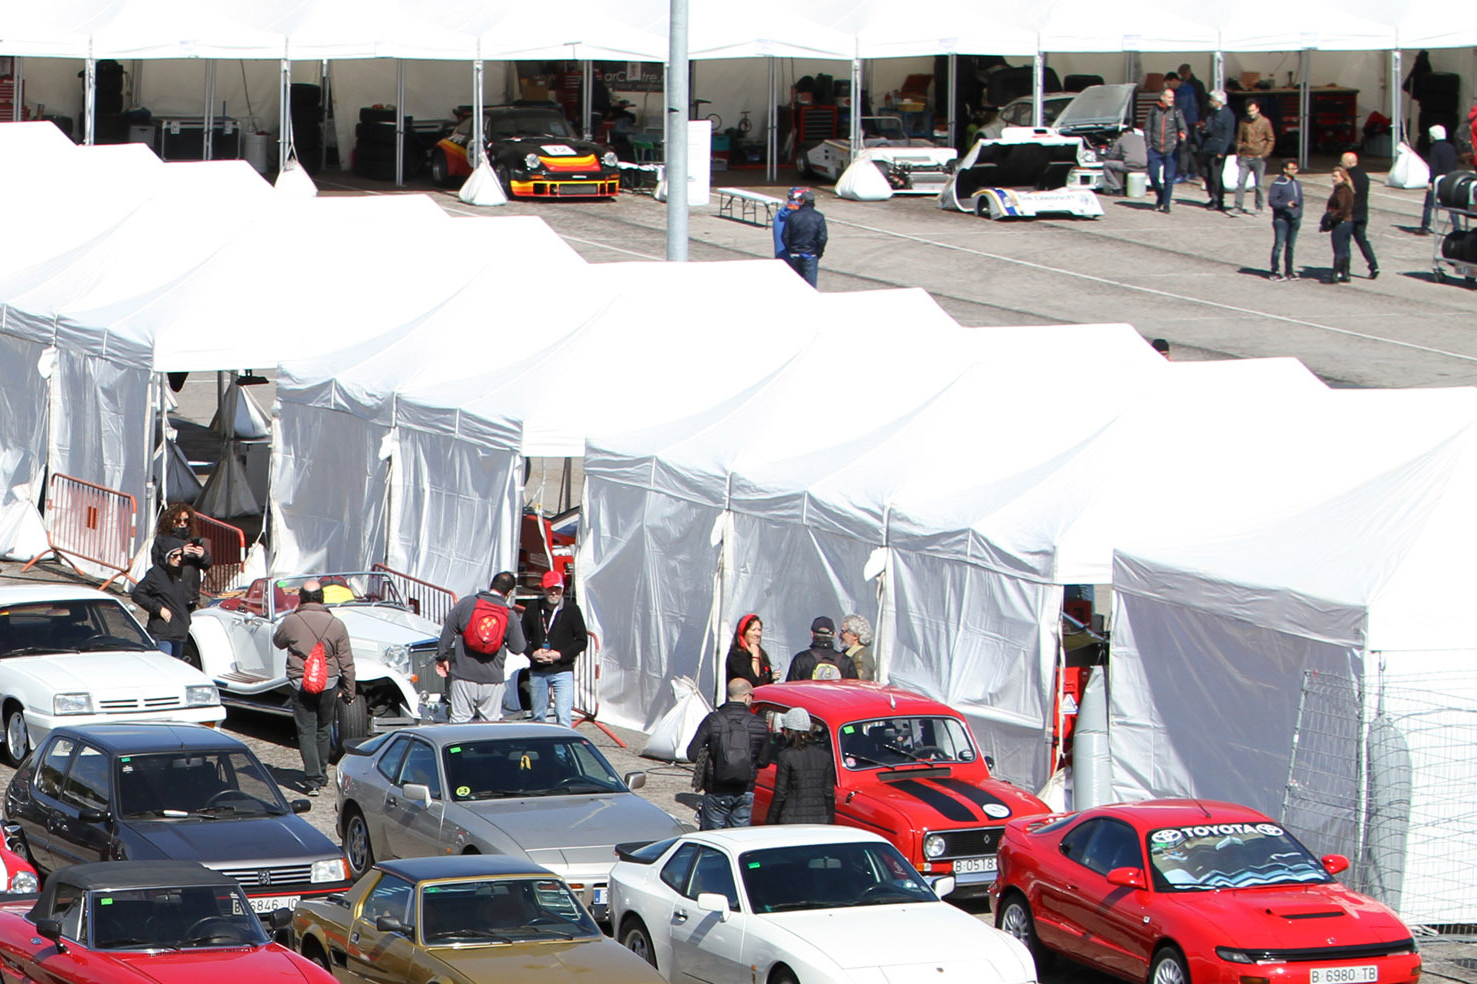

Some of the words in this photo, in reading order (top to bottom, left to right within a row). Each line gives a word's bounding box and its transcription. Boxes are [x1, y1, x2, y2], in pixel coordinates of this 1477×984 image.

[1180, 824, 1258, 837] TOYOTA
[966, 858, 994, 872] 0518
[1325, 968, 1355, 982] 6980
[1362, 967, 1376, 981] TB
